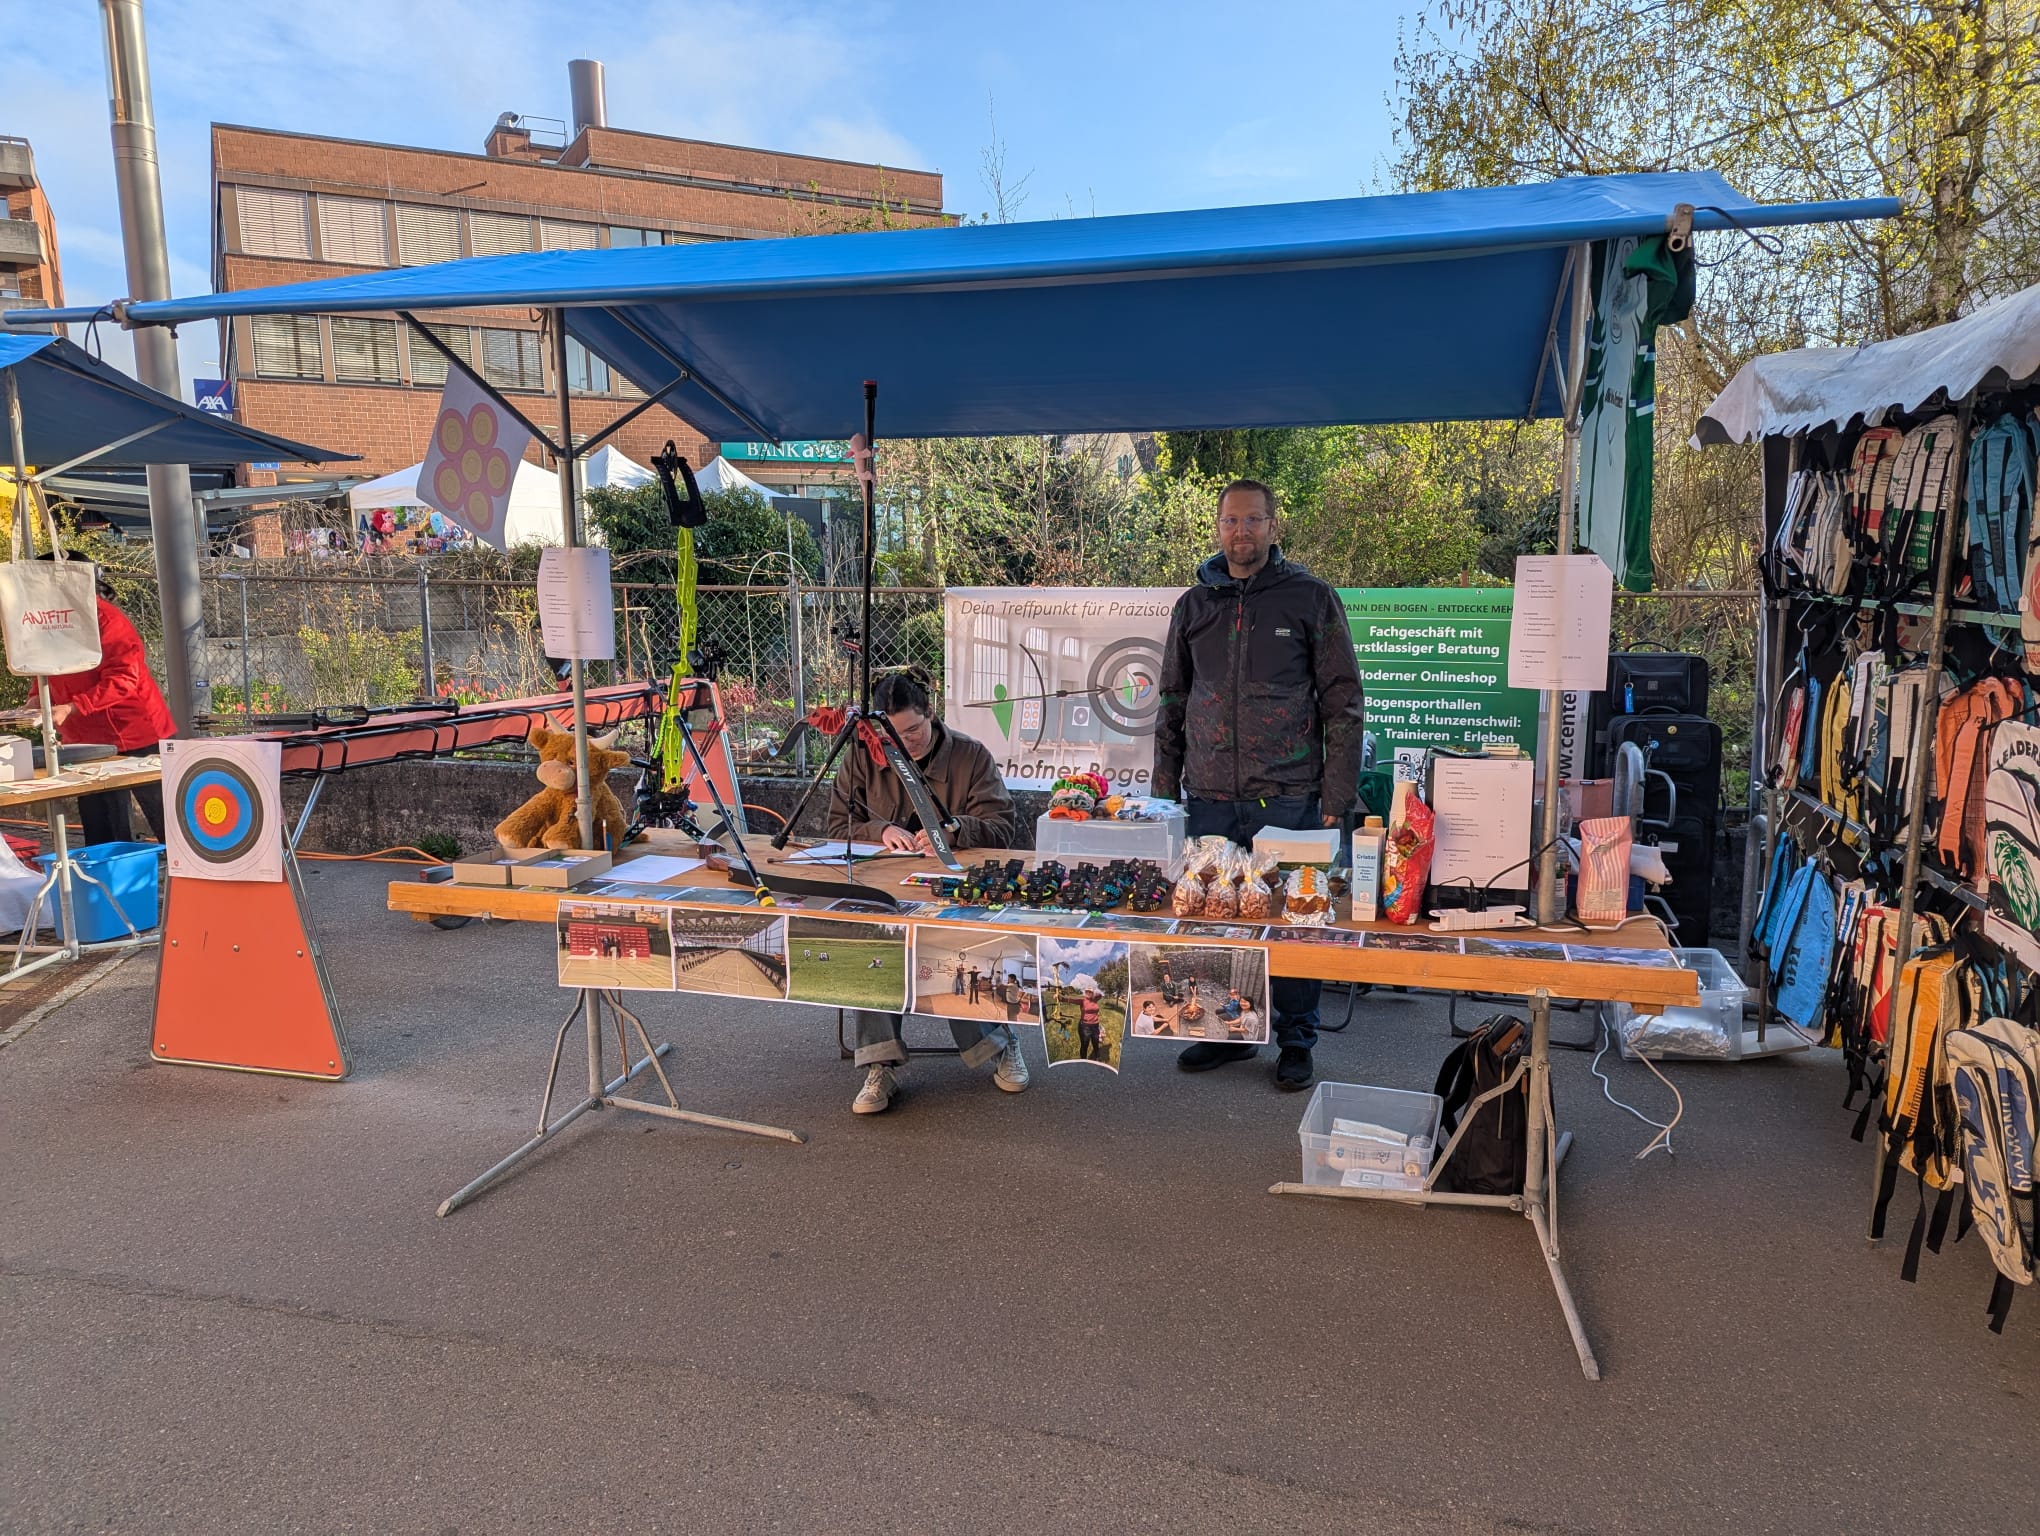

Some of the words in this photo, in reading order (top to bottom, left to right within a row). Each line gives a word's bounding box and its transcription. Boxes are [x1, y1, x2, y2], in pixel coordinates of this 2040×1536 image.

[196, 395, 228, 411] AXA
[747, 442, 800, 458] BANK
[961, 600, 995, 615] Dein
[1001, 600, 1078, 619] Treffpunkt
[1081, 600, 1105, 619] für
[1108, 601, 1173, 617] Präzisio
[1371, 604, 1391, 612] DEN
[1394, 604, 1428, 612] BOGEN
[1437, 604, 1489, 613] ENTDECKE
[1369, 625, 1456, 640] Fachgeschäft
[1460, 627, 1483, 638] mit
[1438, 643, 1500, 658] Beratung
[1421, 670, 1497, 687] Onlineshop
[1364, 696, 1481, 711] Bogensporthallen
[1409, 713, 1421, 724] &
[1425, 714, 1522, 728] Hunzenschwil:
[1384, 728, 1450, 741] Trainieren
[1464, 730, 1515, 743] Erleben
[894, 759, 916, 785] HOYT
[590, 947, 598, 957] 2
[610, 946, 618, 960] 1
[629, 949, 637, 960] 3
